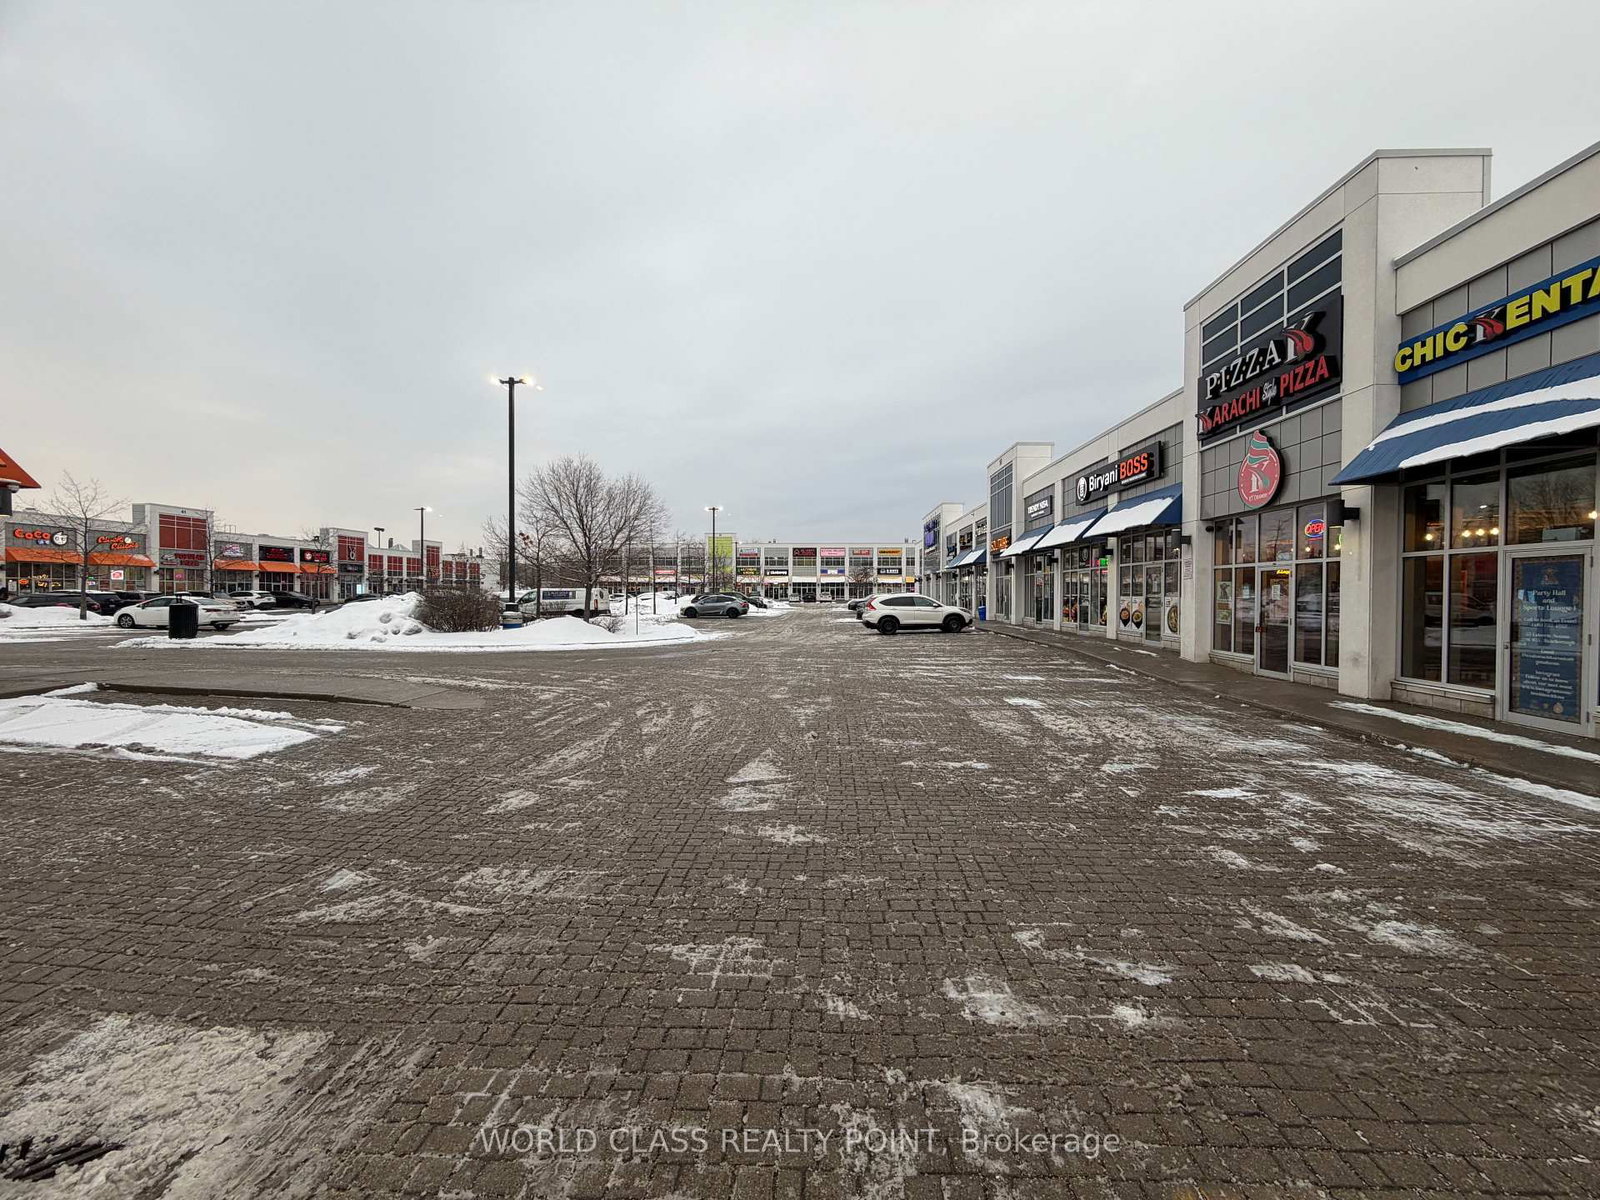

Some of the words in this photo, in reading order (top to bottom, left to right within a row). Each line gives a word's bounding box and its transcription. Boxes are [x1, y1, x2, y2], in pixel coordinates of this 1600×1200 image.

[1195, 387, 1260, 434] KARACHI
[1280, 355, 1329, 398] PIZZA
[1089, 465, 1118, 491] Biryani
[1119, 453, 1148, 480] BOSS
[1306, 522, 1326, 534] OPEN
